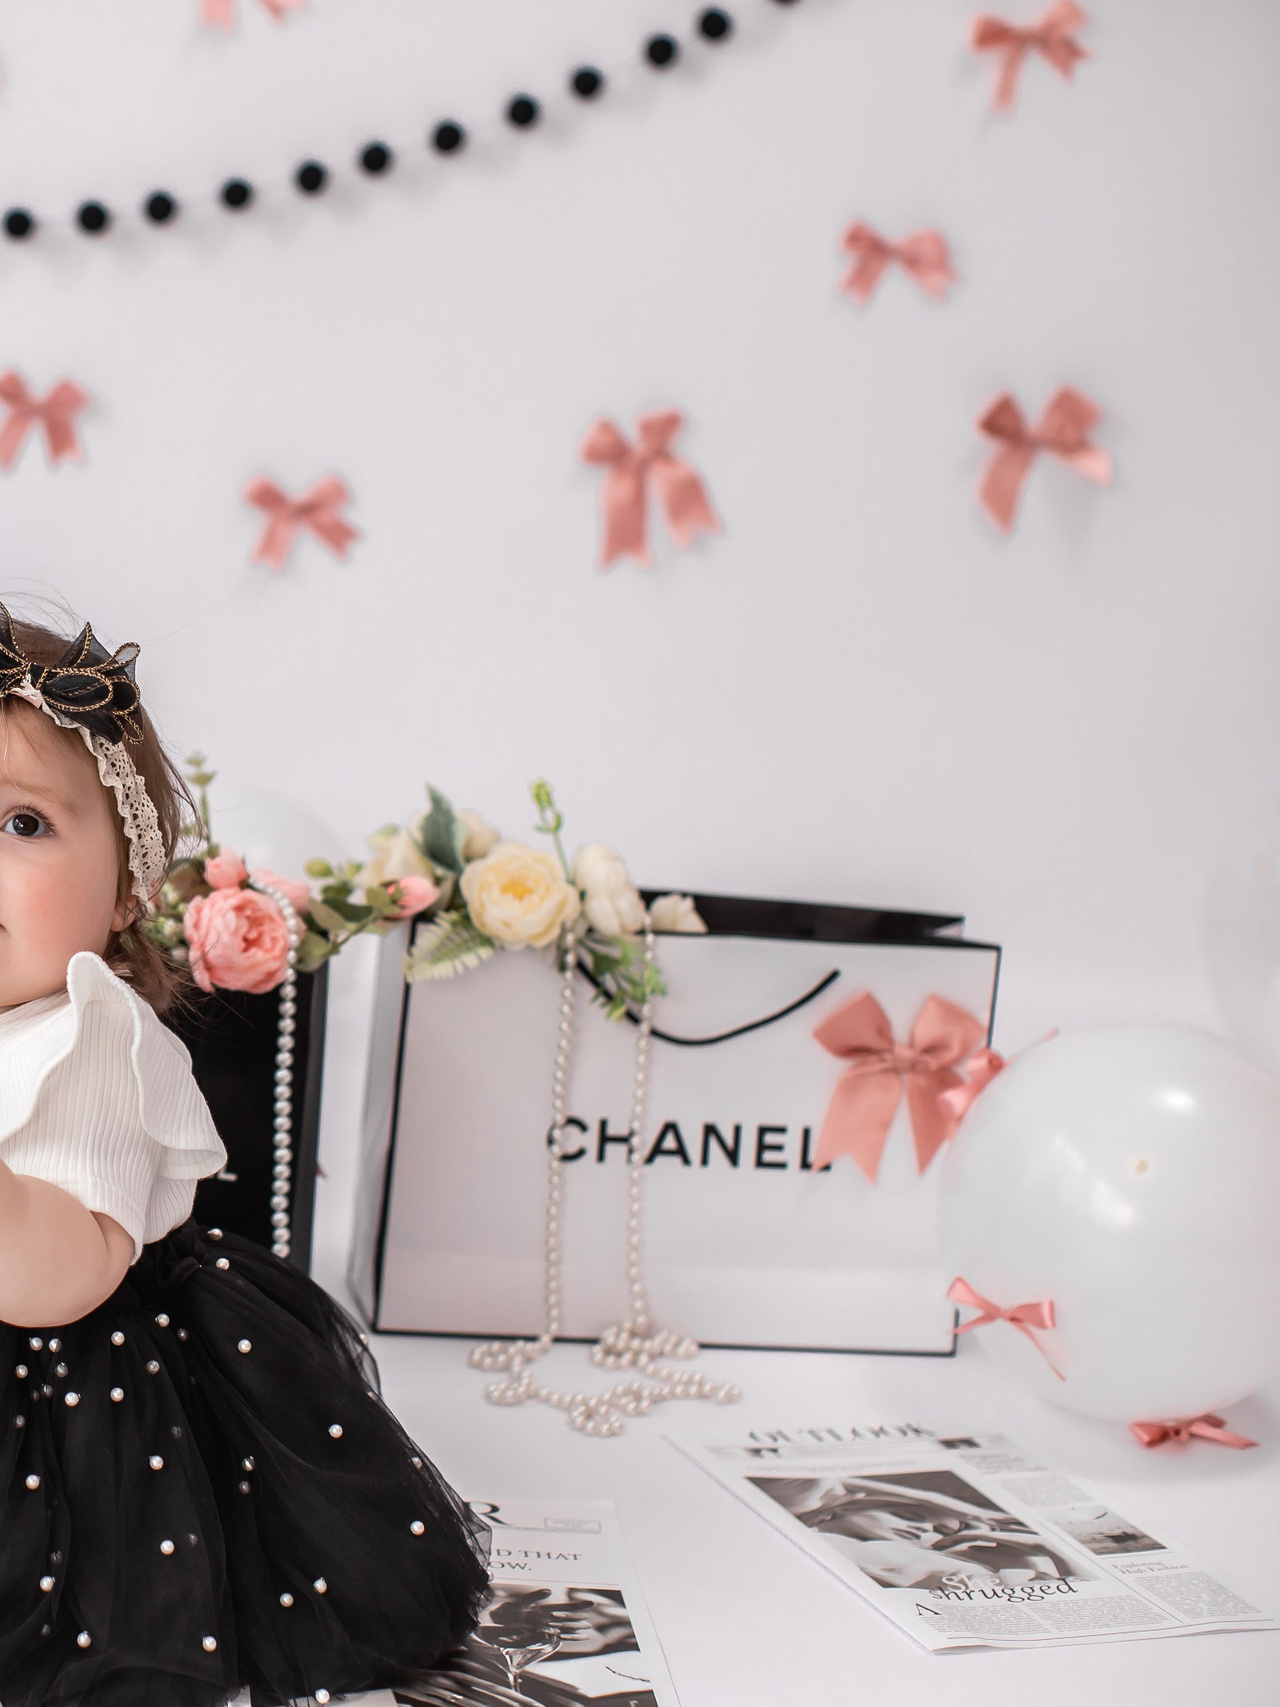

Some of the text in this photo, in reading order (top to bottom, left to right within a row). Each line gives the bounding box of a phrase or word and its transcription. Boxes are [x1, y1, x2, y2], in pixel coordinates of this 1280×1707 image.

[546, 1115, 832, 1172] CHANEL
[747, 1423, 936, 1443] OUTLOOK
[518, 1550, 583, 1561] THAT
[928, 1577, 1079, 1604] shrugged
[941, 1574, 1006, 1593] She
